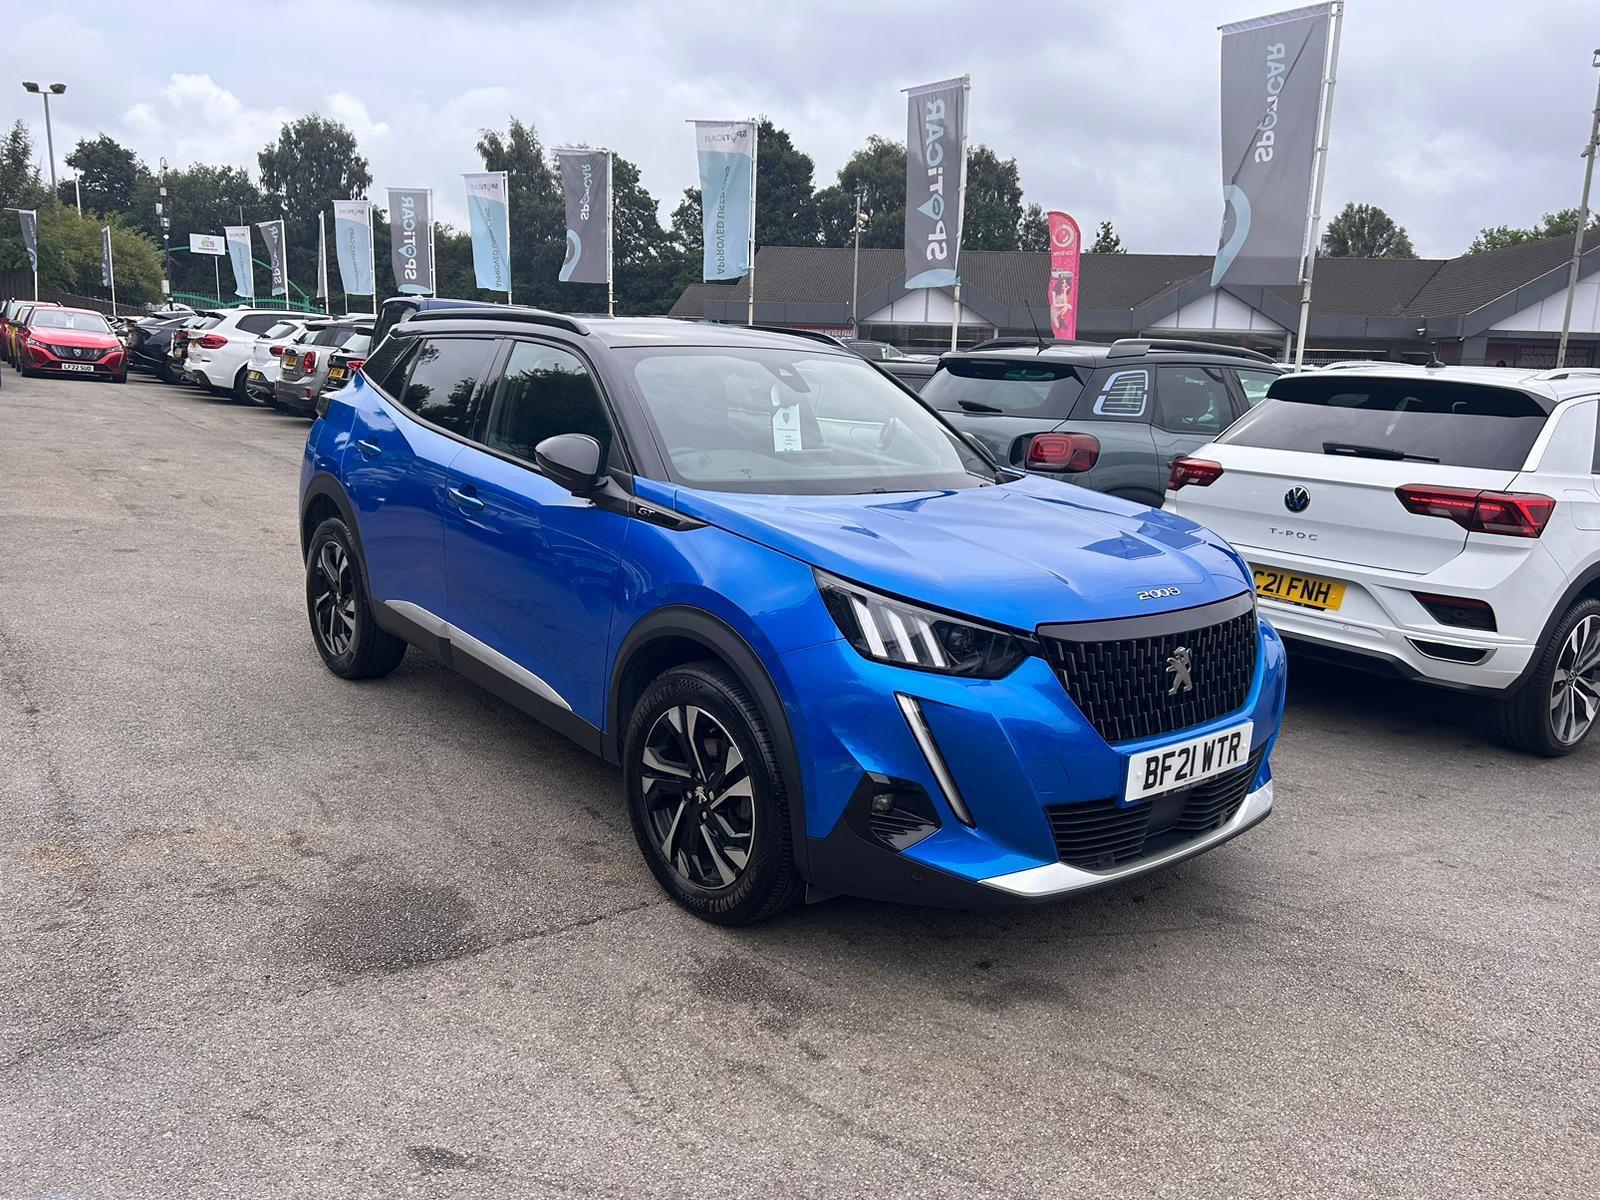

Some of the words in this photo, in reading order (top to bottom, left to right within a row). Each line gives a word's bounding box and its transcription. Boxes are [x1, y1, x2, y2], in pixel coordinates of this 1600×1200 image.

[638, 507, 656, 517] GT
[1269, 527, 1319, 541] T-ROC
[1136, 586, 1181, 601] 2008
[1286, 576, 1332, 603] FNH
[1142, 745, 1197, 791] BF21
[1202, 731, 1242, 773] WTR
